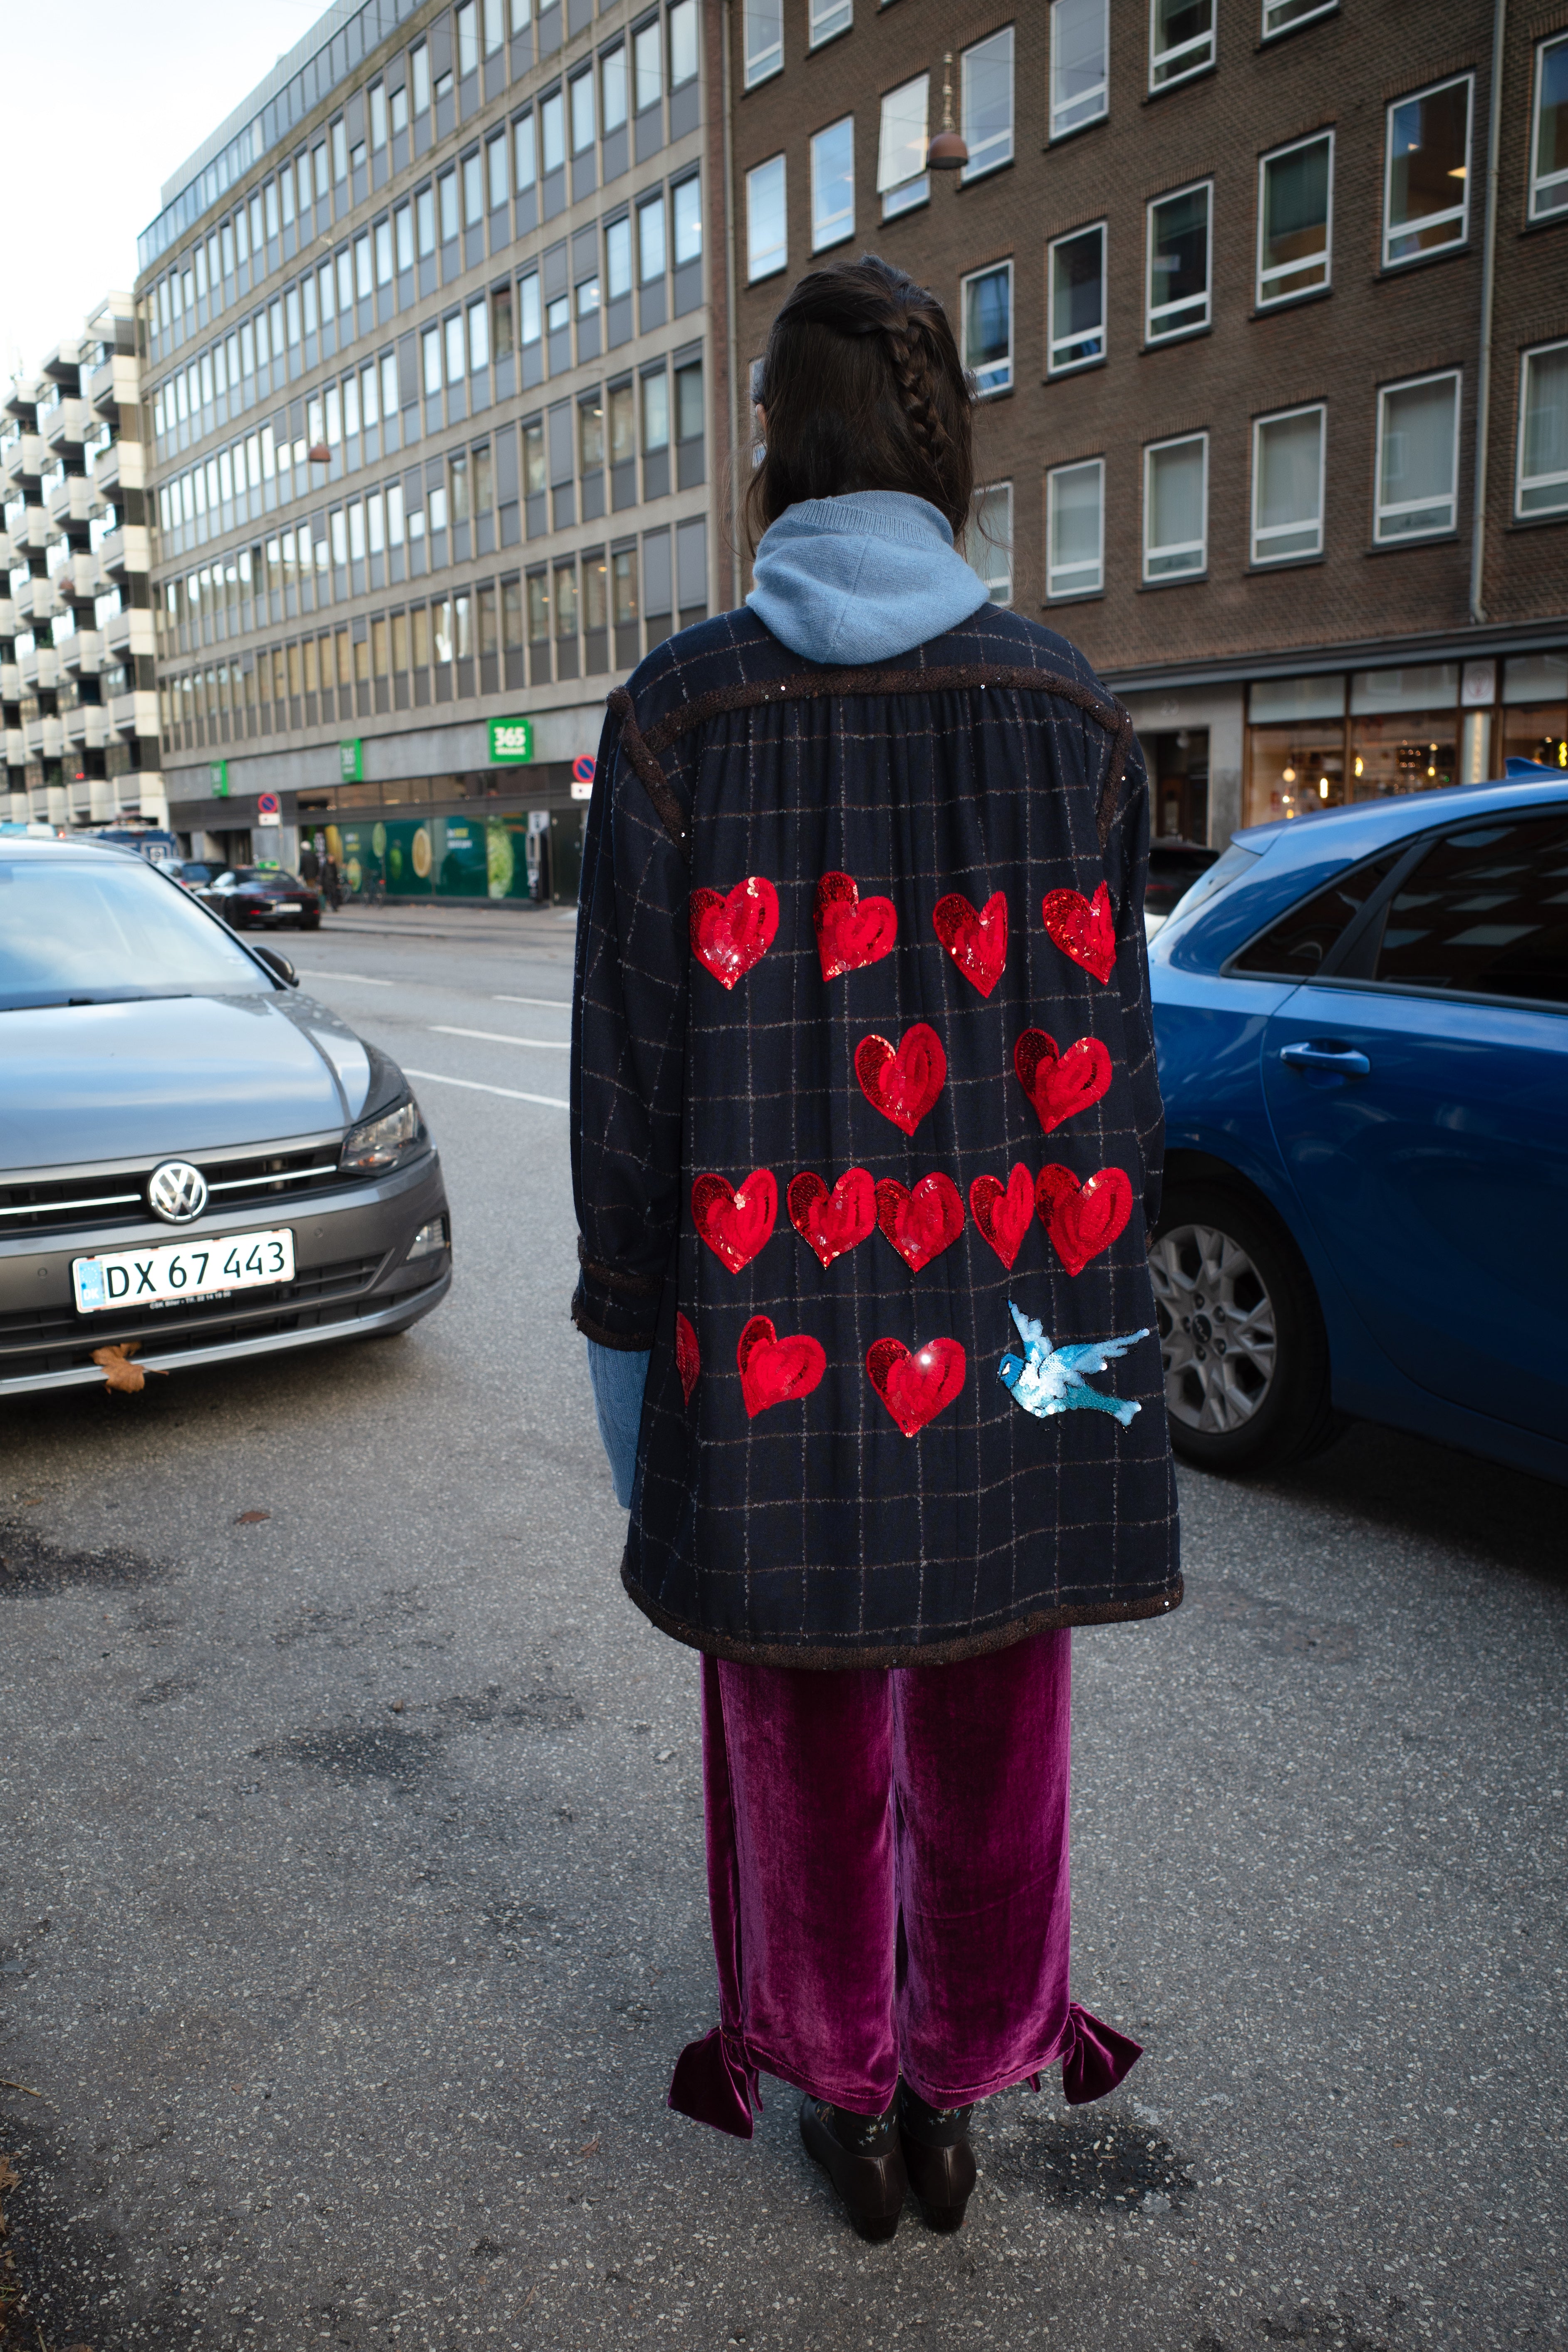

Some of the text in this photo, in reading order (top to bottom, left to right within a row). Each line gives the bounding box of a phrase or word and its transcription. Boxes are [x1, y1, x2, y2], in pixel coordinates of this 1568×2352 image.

[493, 726, 526, 747] 365
[107, 1242, 285, 1299] DX 67 443
[83, 1287, 99, 1301] DK
